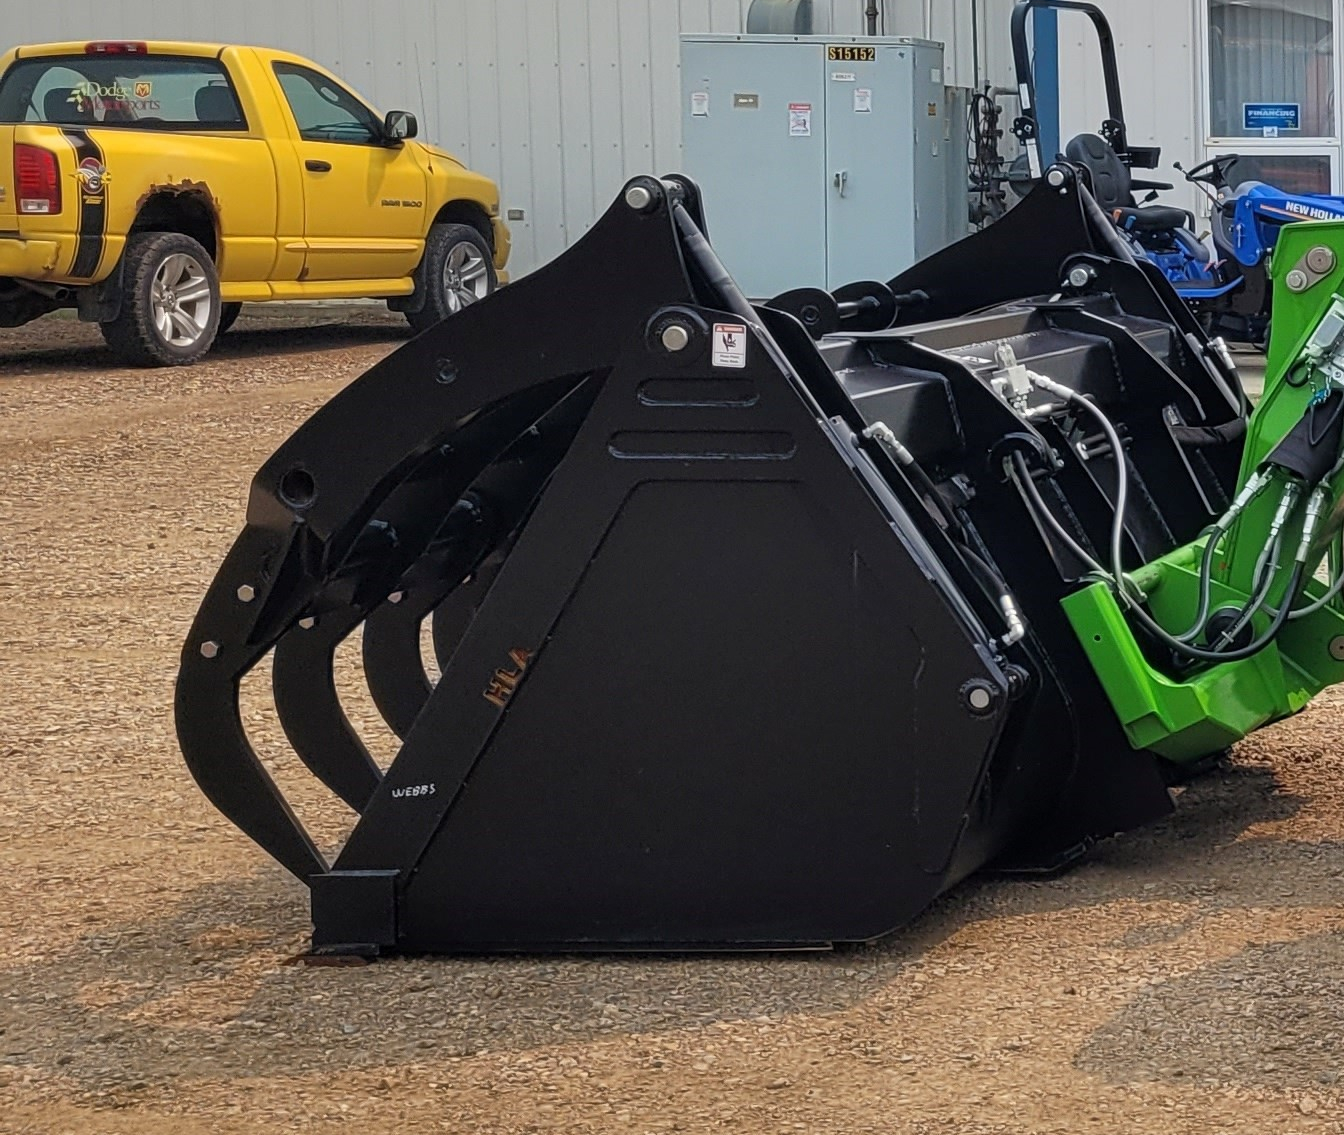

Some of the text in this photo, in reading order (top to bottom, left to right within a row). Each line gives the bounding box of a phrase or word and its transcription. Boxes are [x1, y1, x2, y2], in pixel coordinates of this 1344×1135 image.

[829, 47, 874, 60] S15152
[1286, 201, 1309, 215] NEW
[391, 783, 436, 798] WEBBS
